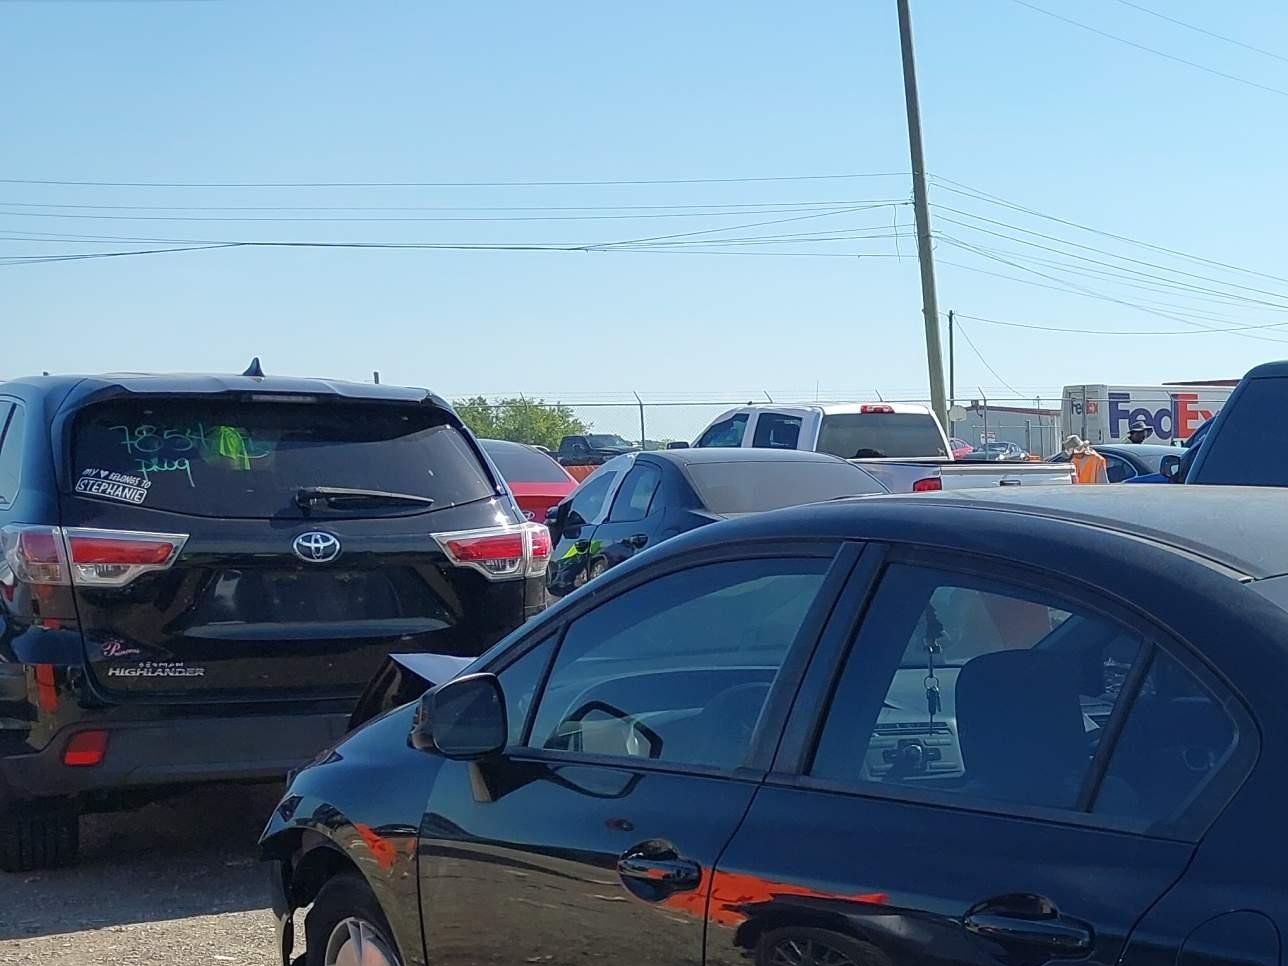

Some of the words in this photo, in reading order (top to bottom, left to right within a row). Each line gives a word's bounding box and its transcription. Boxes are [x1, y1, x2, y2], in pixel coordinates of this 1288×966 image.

[108, 472, 142, 485] BELONGS
[140, 479, 152, 489] TO
[78, 479, 146, 502] STEPHANIE
[108, 667, 206, 677] HIGHLANDER
